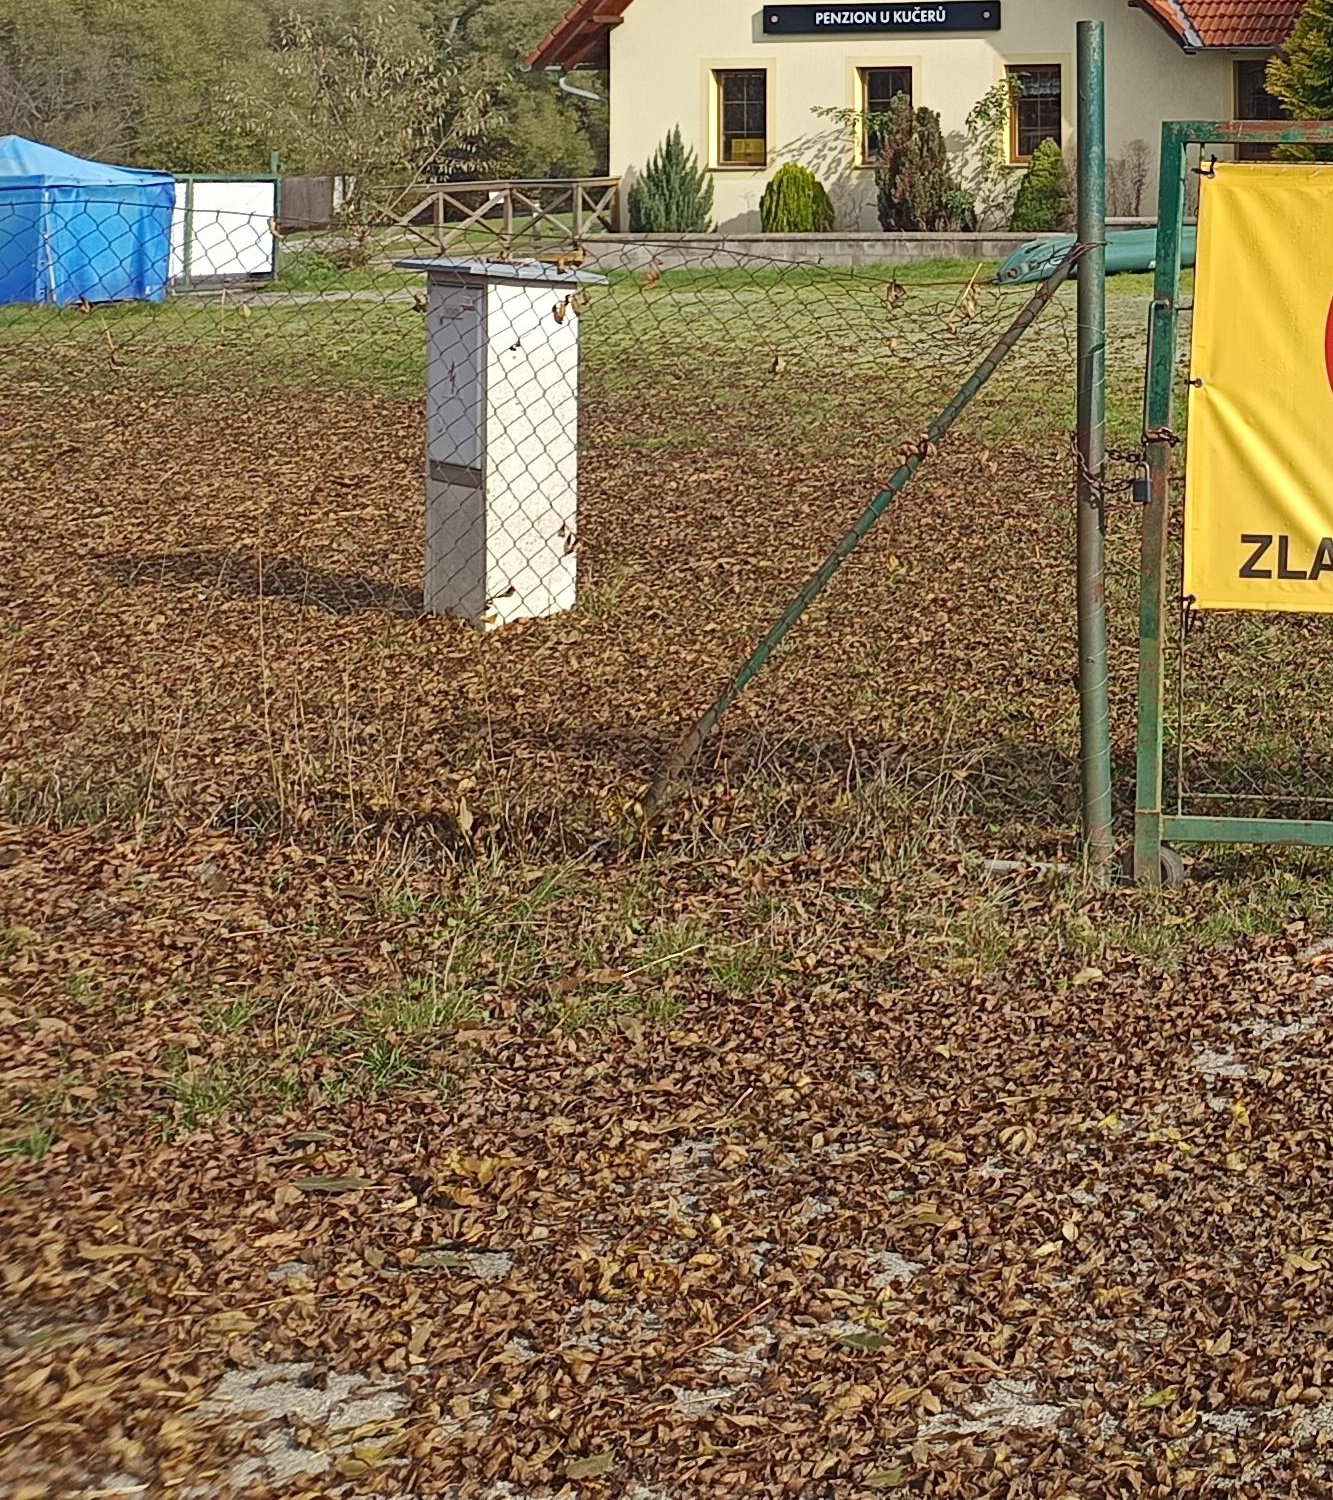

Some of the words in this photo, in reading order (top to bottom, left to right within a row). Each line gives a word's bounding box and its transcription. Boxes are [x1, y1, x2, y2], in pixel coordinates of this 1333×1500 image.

[815, 11, 877, 25] PENZION
[879, 11, 890, 23] U
[893, 5, 946, 23] KUČERŮ
